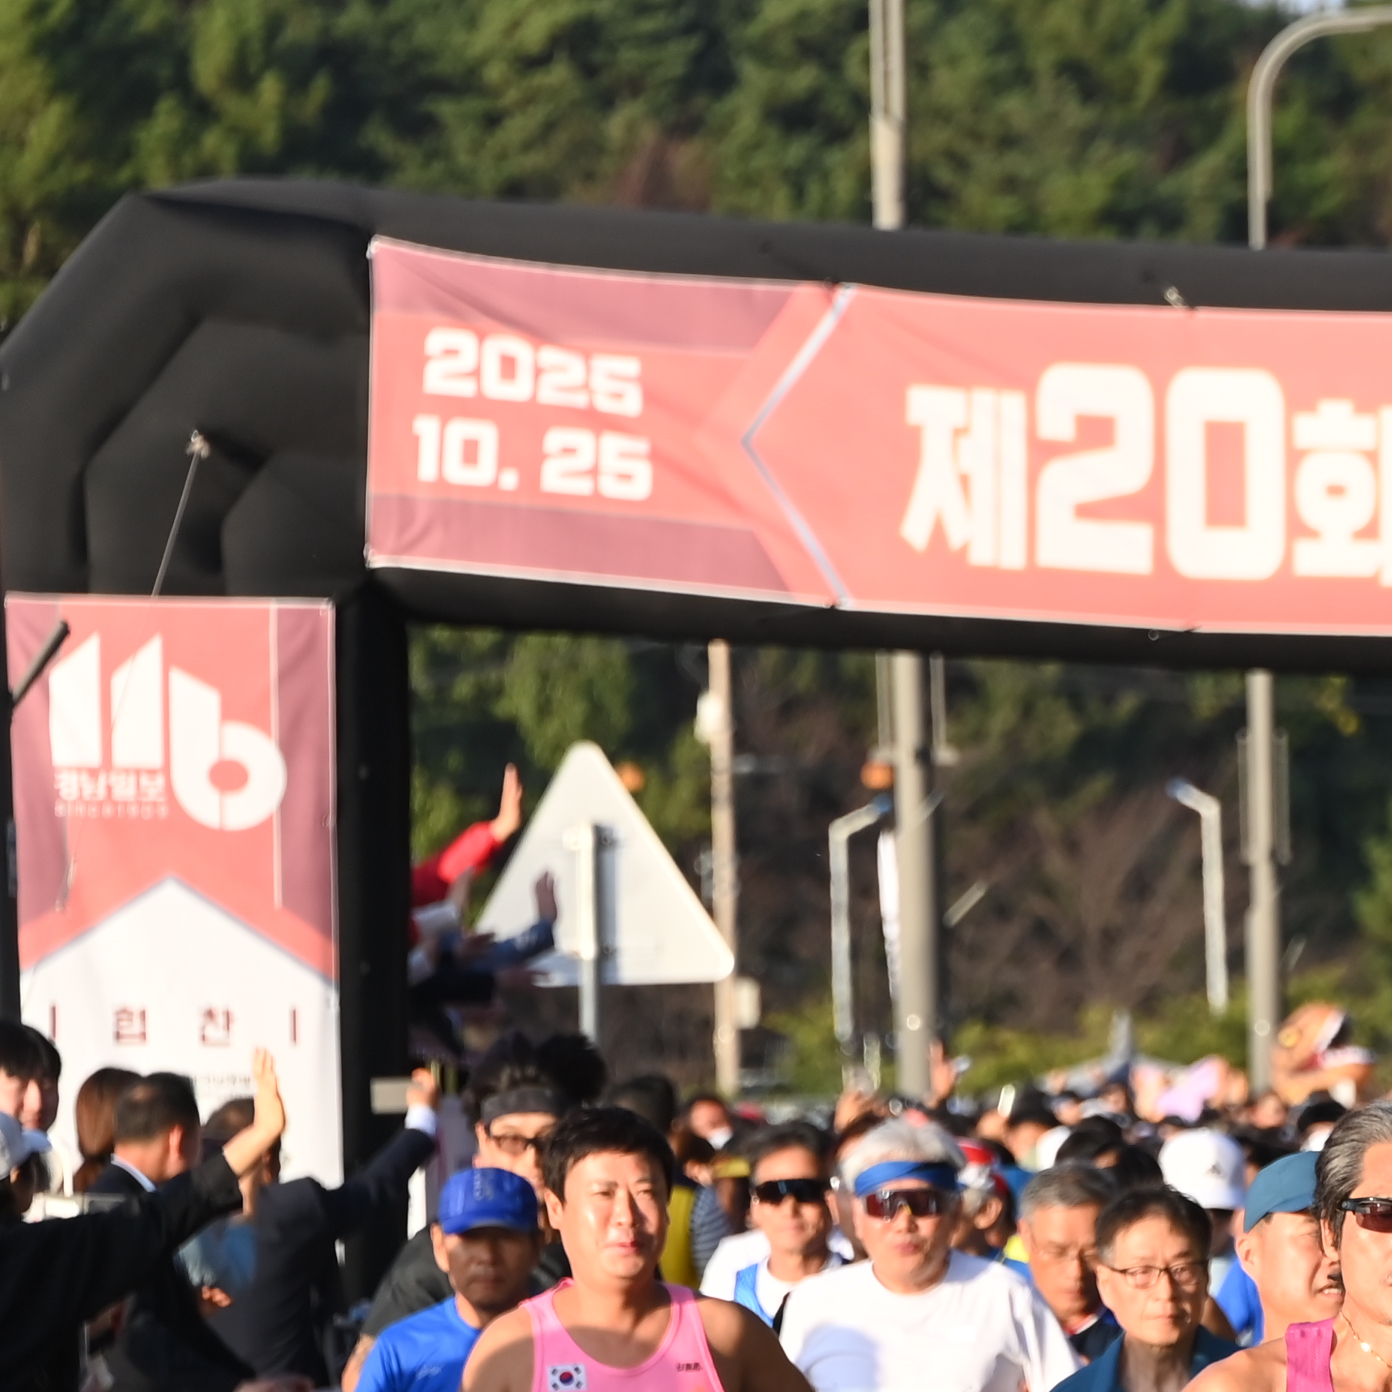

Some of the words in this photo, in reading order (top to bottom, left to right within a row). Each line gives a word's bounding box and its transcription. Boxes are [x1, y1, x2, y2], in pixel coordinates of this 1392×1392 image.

[422, 326, 643, 418] 2025
[412, 414, 520, 492] 10.
[539, 427, 655, 501] 25
